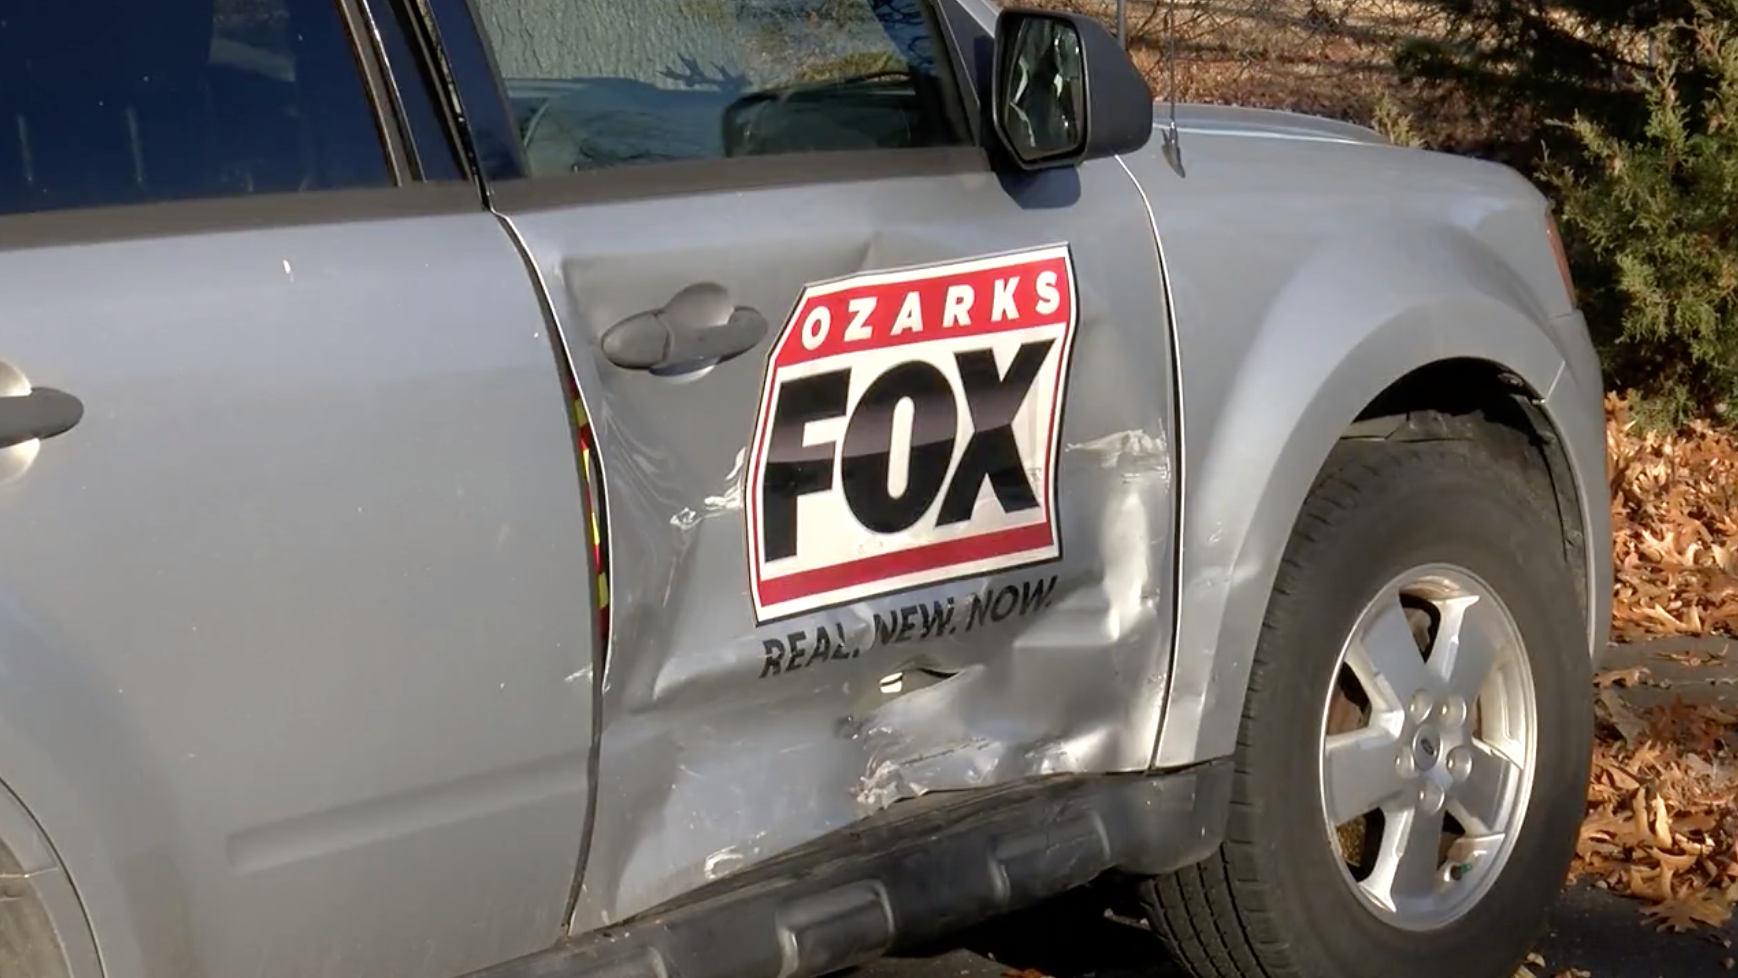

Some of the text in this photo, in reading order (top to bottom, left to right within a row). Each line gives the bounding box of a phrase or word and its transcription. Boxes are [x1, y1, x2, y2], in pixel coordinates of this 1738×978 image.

[802, 271, 1060, 350] OZARKS
[764, 338, 1056, 563] FOX
[759, 622, 860, 678] REAL.
[873, 596, 956, 645] NEW.
